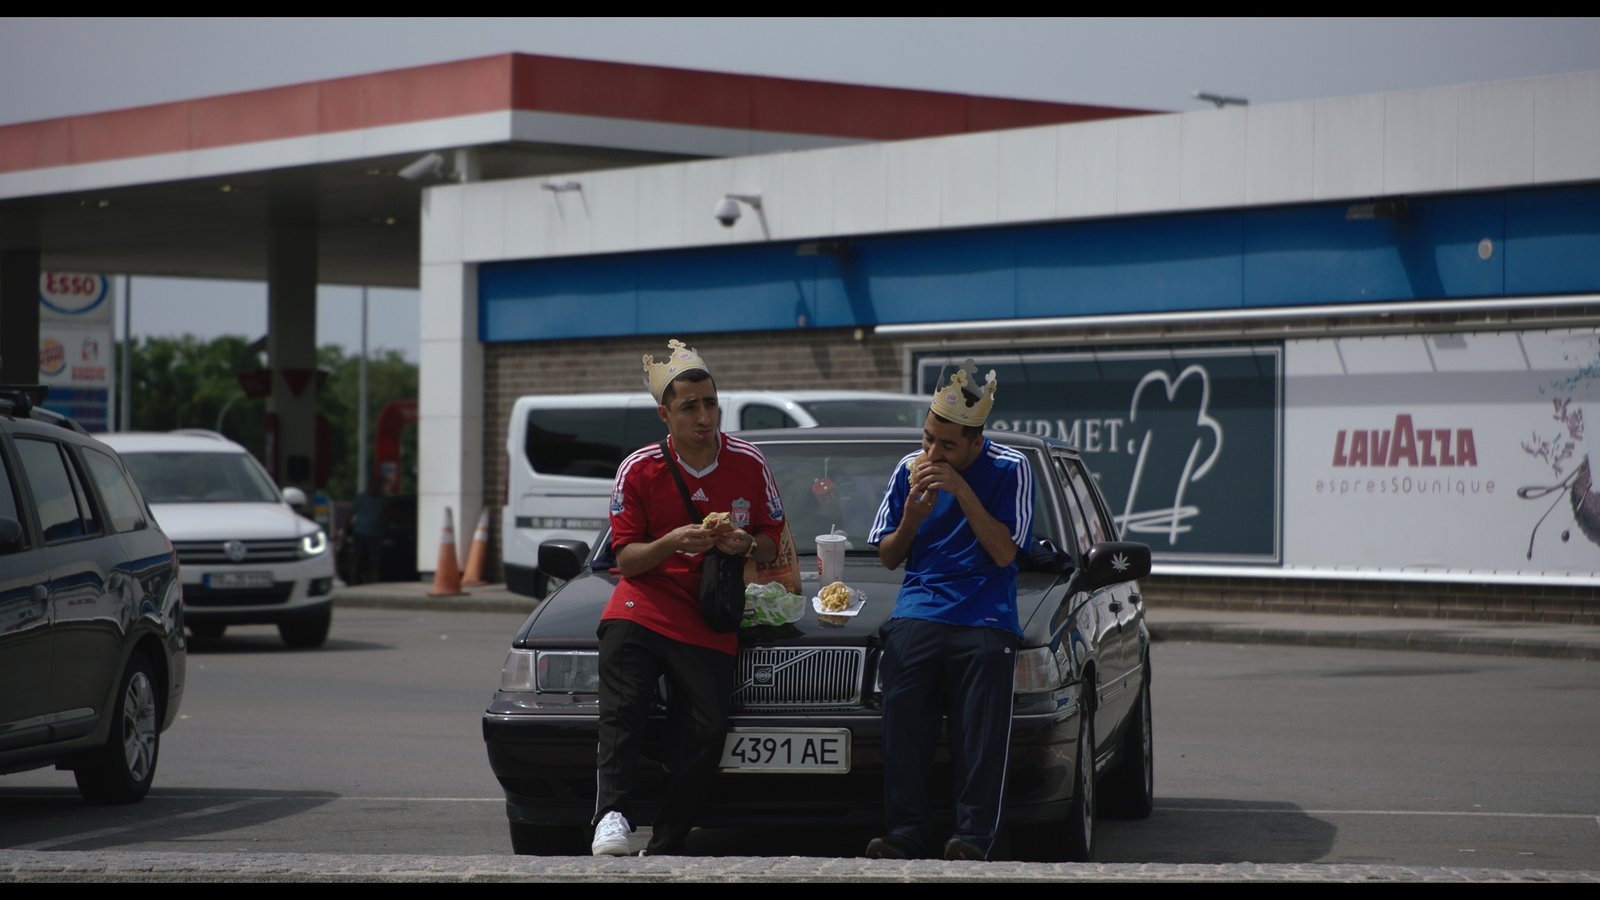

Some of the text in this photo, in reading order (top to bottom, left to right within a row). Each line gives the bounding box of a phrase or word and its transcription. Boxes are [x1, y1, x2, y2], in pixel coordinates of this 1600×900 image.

[1332, 413, 1478, 467] LAVAZZA
[731, 737, 839, 765] 4391 AE
